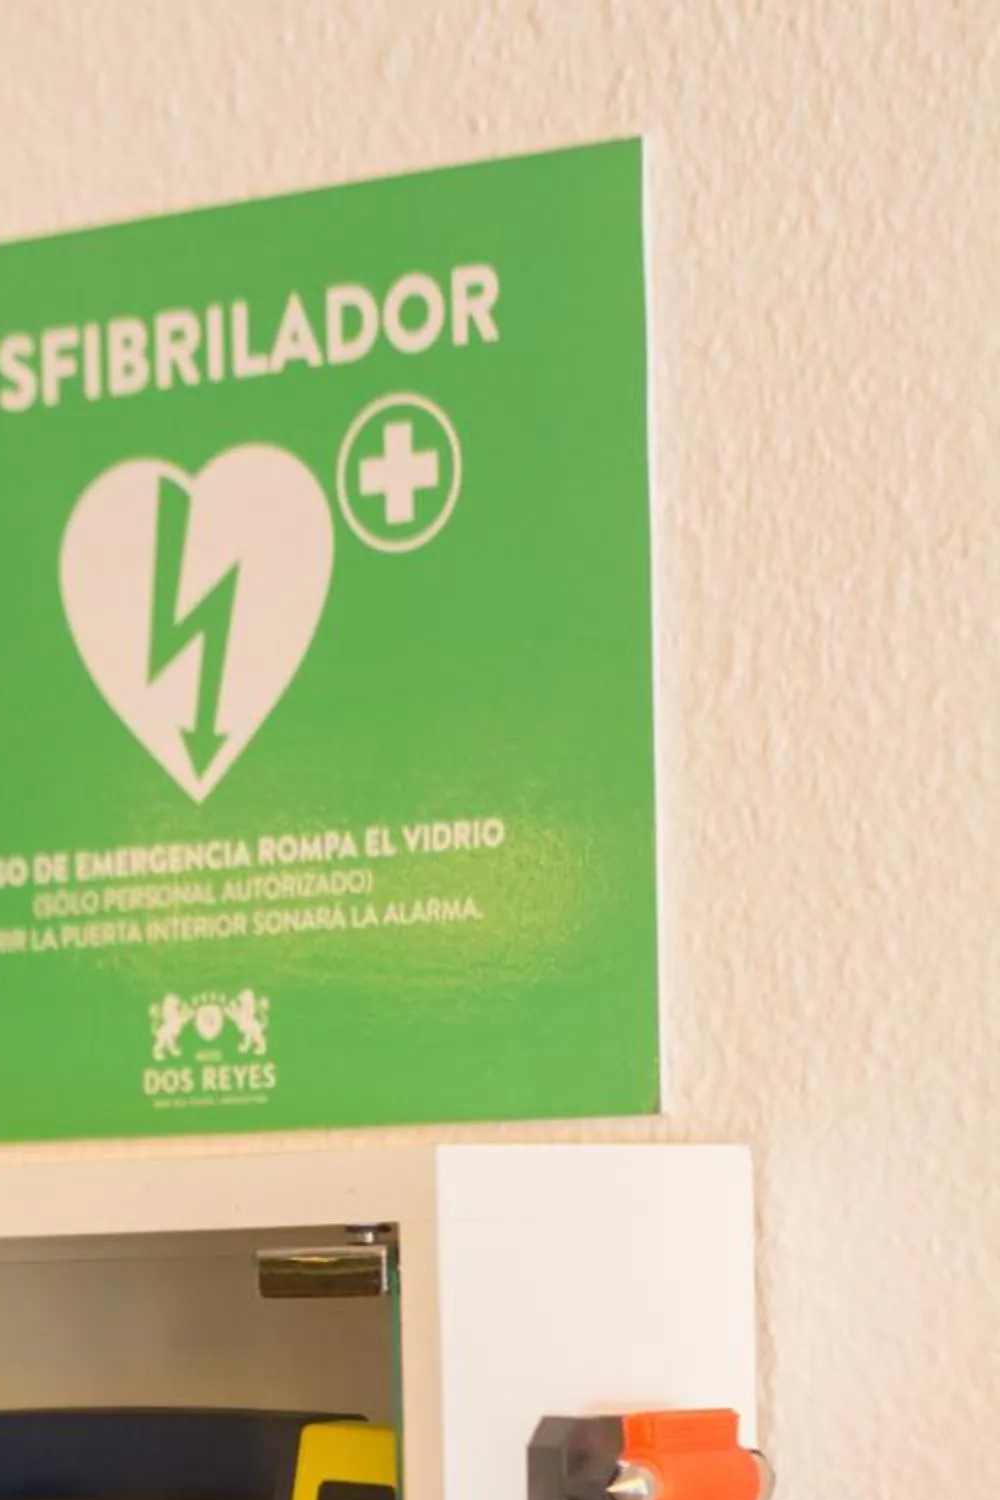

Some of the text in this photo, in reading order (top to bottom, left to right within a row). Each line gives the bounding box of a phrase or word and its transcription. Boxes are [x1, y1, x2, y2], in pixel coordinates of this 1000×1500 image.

[32, 852, 69, 885] DE
[75, 840, 251, 880] EMERGENCIA
[257, 830, 359, 865] ROMPA
[365, 826, 397, 857] EL
[402, 818, 506, 853] VIDRIO
[103, 881, 215, 912] PERSONAL
[31, 925, 59, 952] LA
[61, 919, 142, 949] PUERTA
[148, 912, 248, 942] INTERIOR
[351, 905, 378, 929] LA
[143, 1062, 276, 1096] DOS REYES
